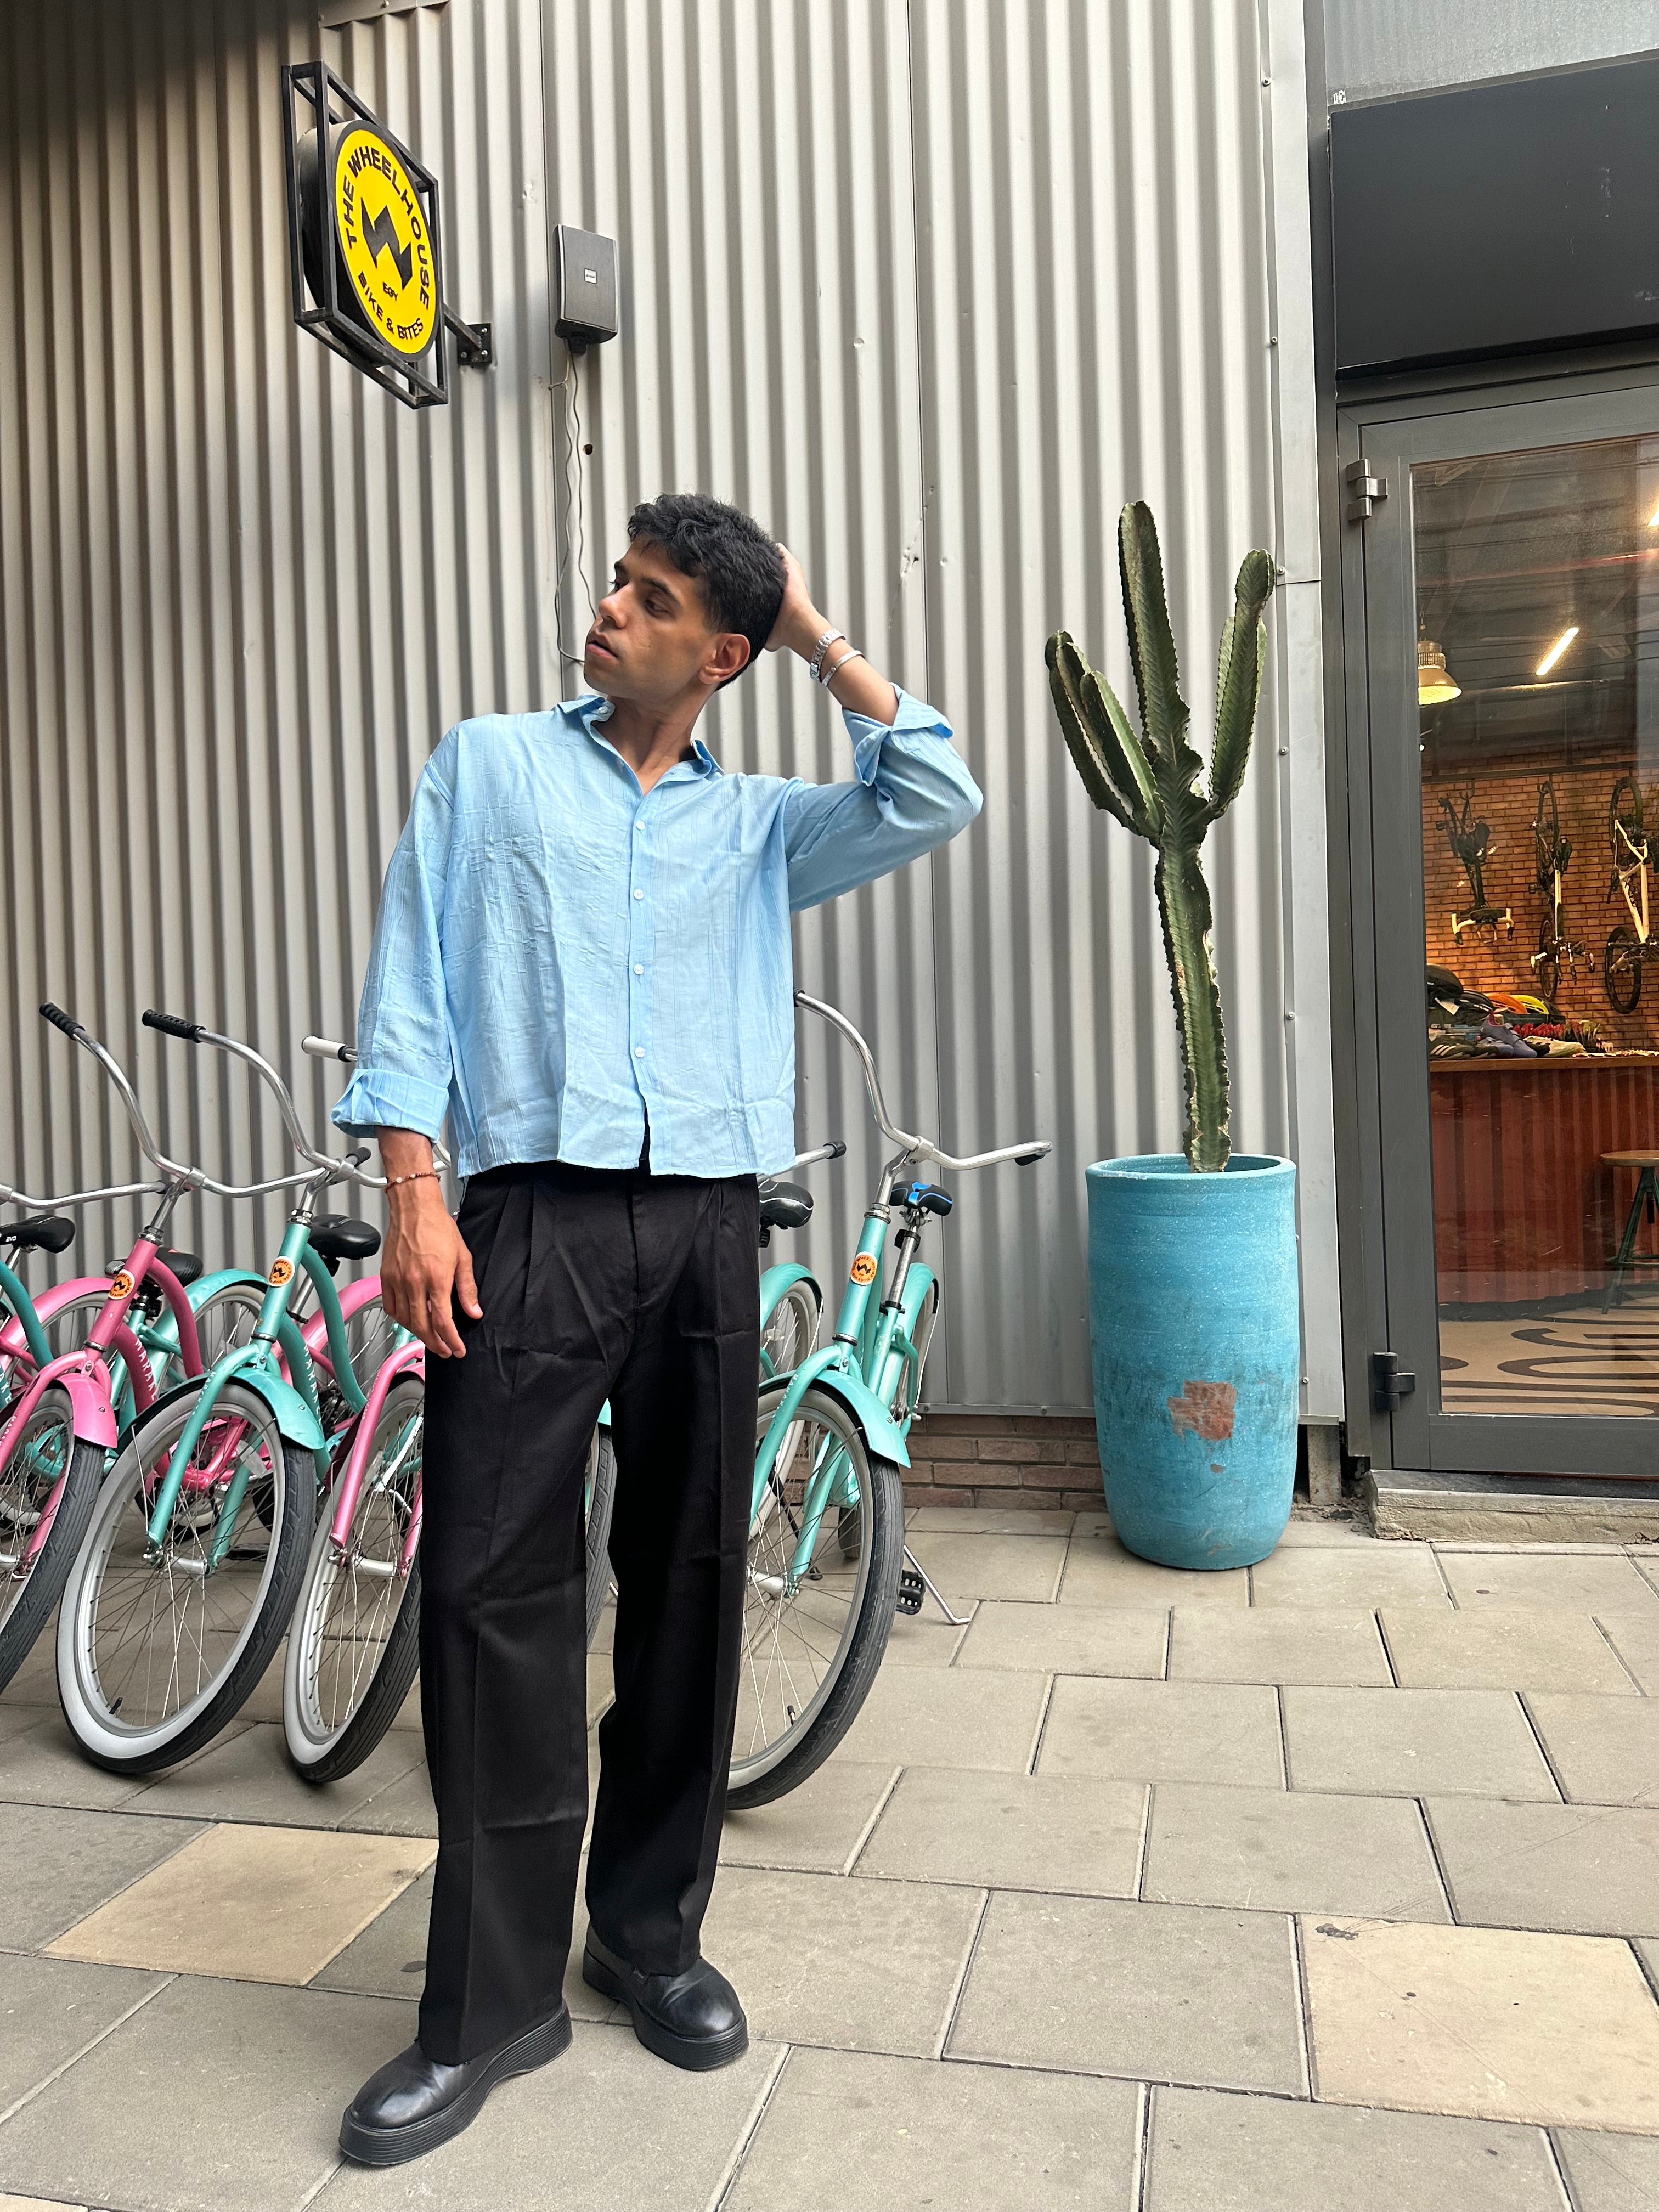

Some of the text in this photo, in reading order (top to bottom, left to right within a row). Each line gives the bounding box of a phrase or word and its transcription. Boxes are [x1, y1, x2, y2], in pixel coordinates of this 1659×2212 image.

[343, 146, 430, 311] THE WHEELHOUSE
[358, 270, 424, 340] BIKE & BITES
